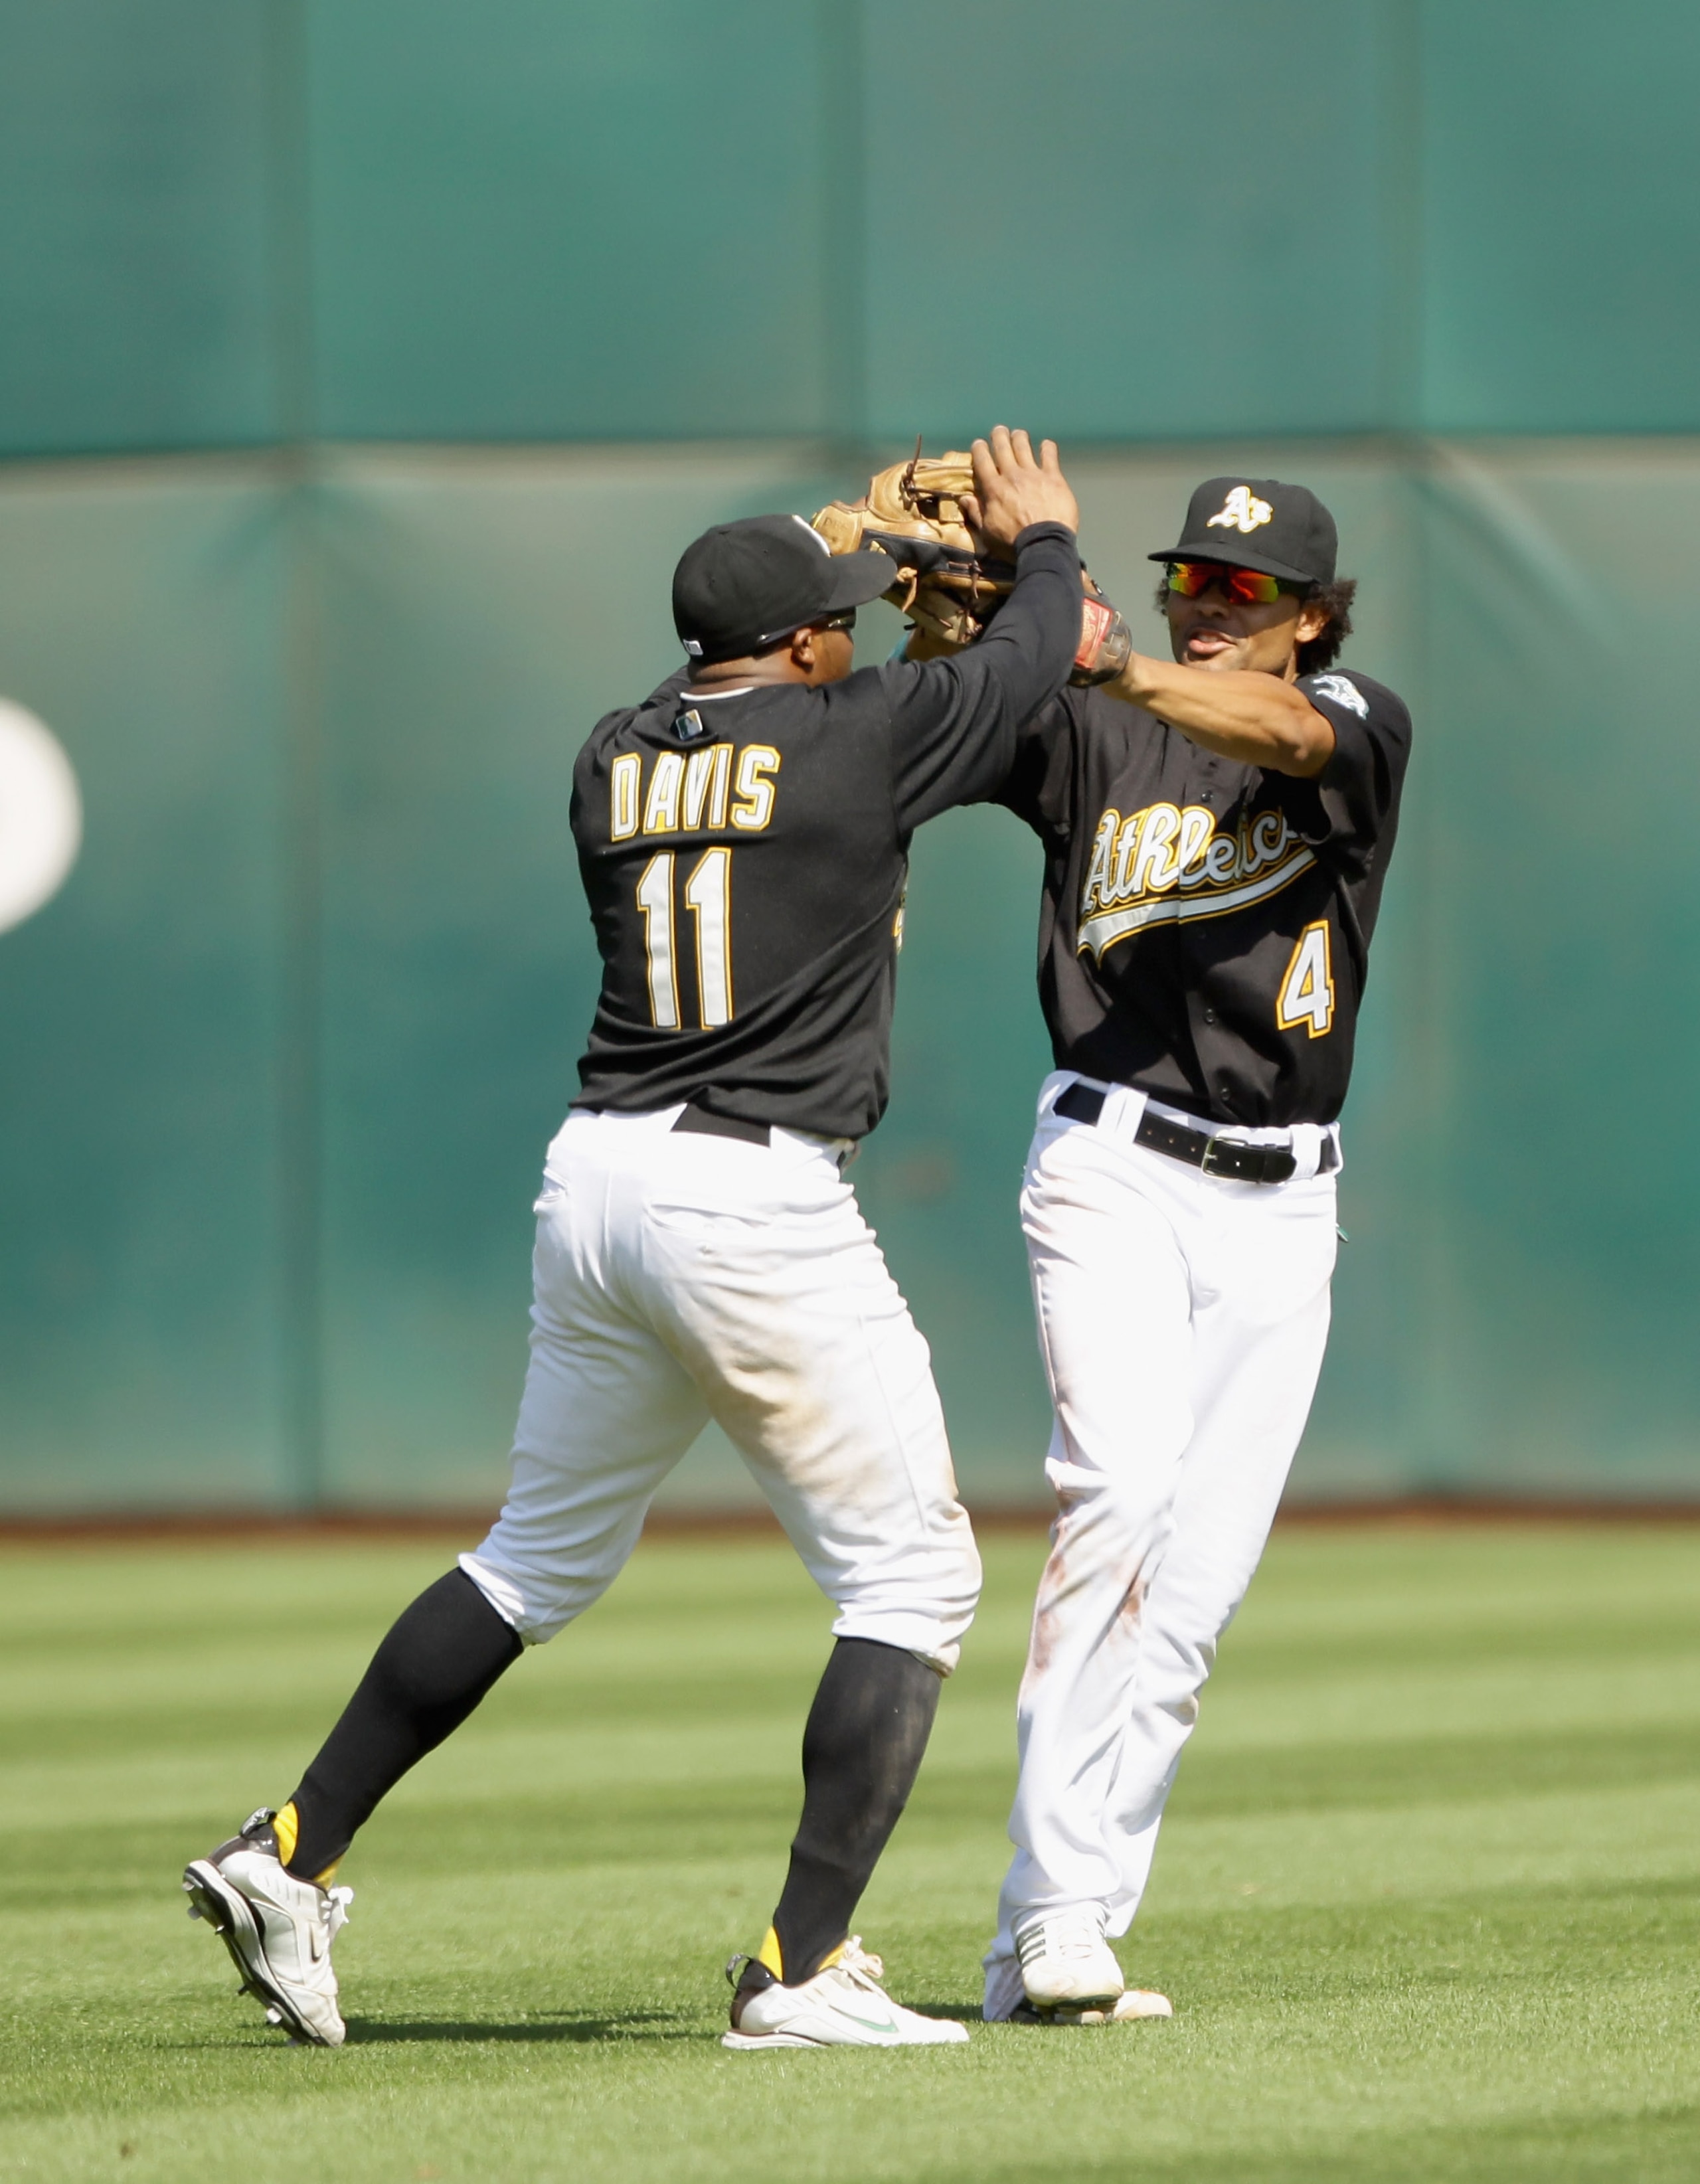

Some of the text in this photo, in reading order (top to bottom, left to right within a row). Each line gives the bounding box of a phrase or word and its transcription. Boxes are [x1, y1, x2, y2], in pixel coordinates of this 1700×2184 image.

[1207, 485, 1274, 533] A's
[610, 743, 782, 843] DAVIS
[636, 846, 734, 1031] 11
[1276, 919, 1335, 1040] 4
